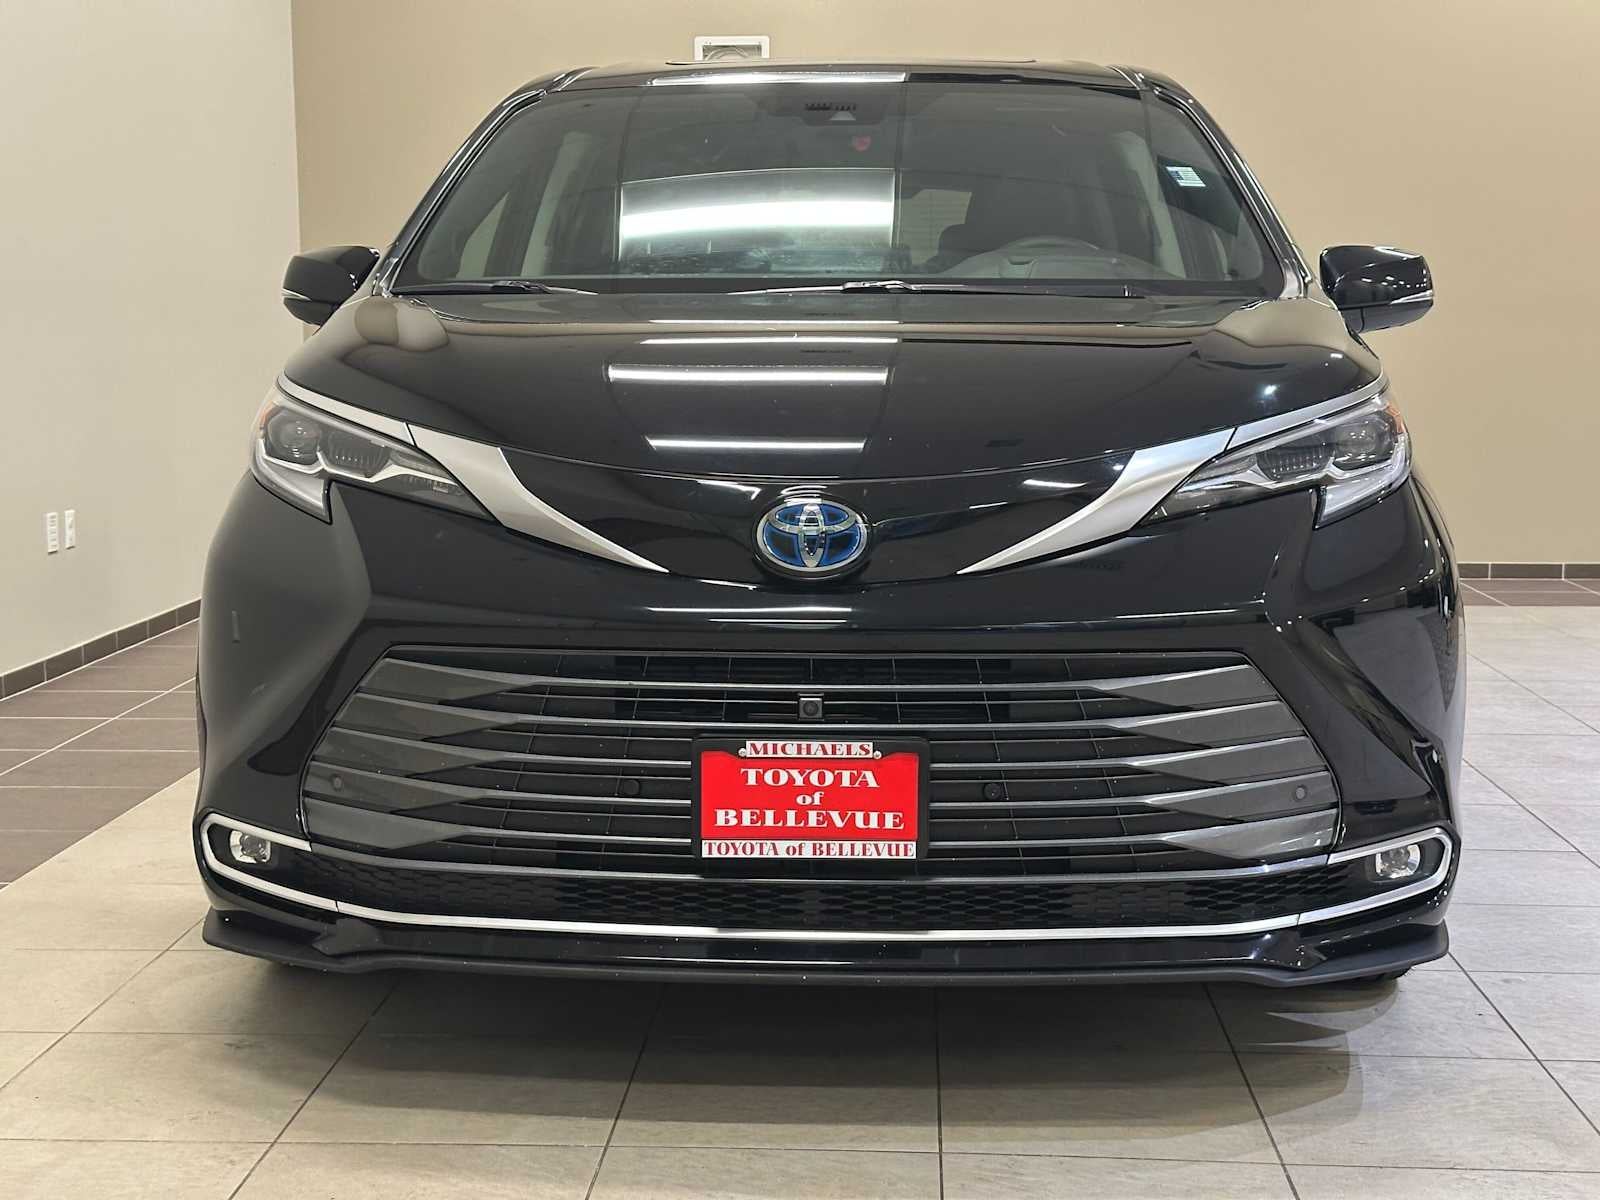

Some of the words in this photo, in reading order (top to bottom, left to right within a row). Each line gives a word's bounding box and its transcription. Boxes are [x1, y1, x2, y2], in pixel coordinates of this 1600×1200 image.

[749, 742, 871, 757] MICHAELS
[741, 768, 879, 788] TOYOTA
[796, 791, 825, 805] of
[715, 809, 904, 829] BELLEVUE
[704, 842, 779, 856] TOYOTA
[785, 842, 806, 857] of
[812, 842, 914, 857] BELLEVUE
